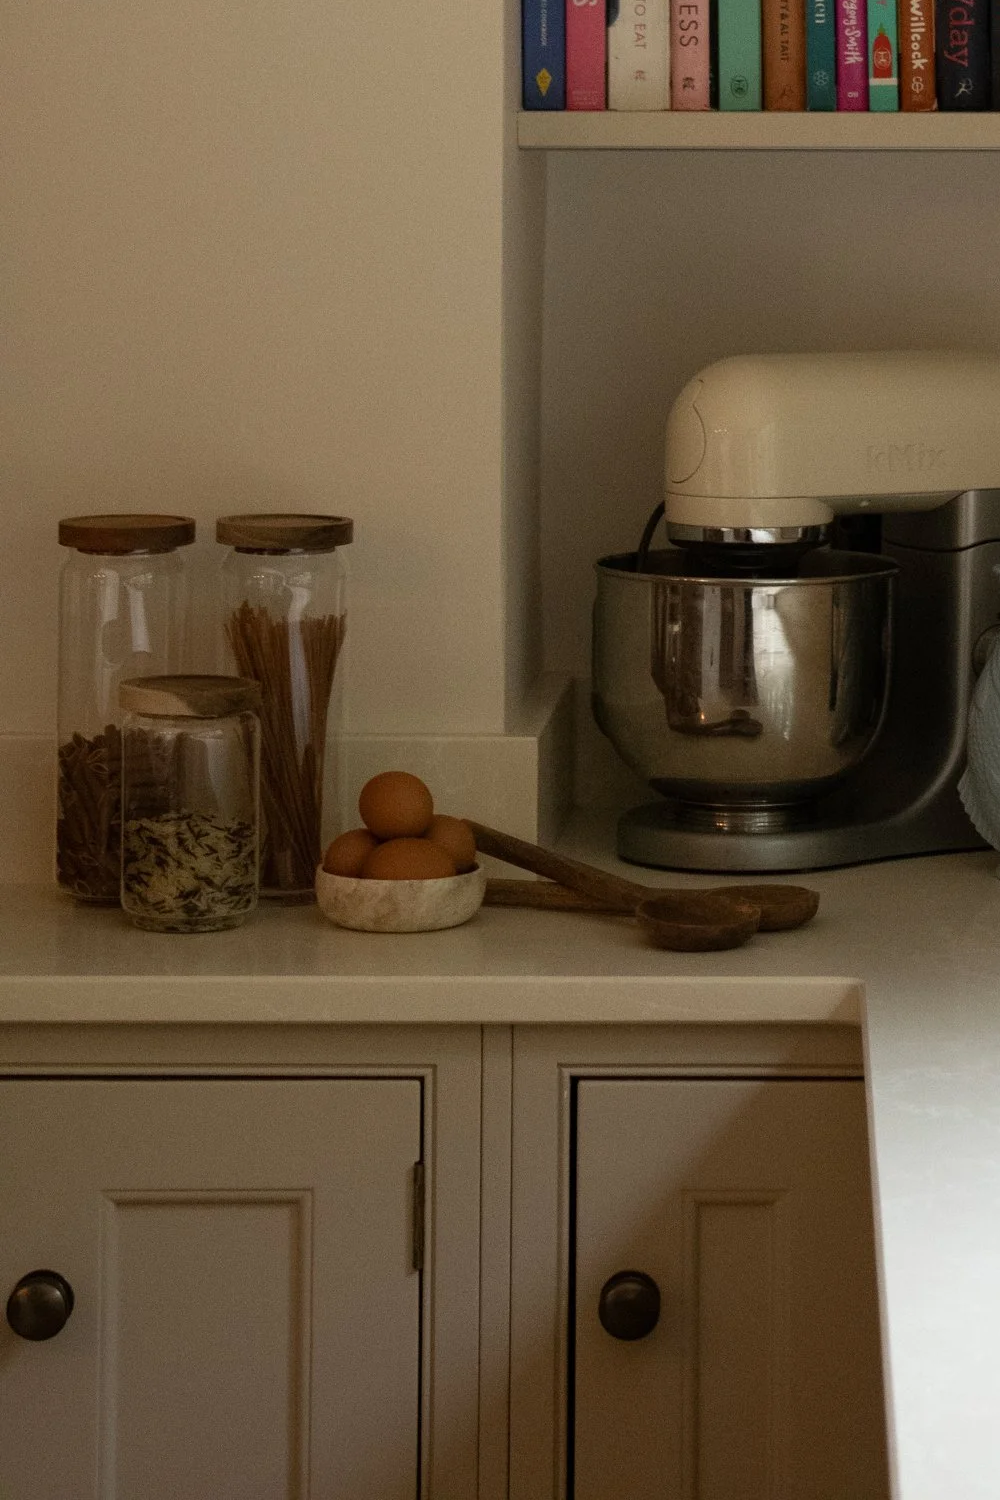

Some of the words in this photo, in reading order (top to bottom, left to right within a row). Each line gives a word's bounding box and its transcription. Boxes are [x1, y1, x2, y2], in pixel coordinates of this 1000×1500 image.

[634, 22, 645, 48] EAT
[780, 22, 789, 36] AL
[780, 39, 789, 61] TAIT
